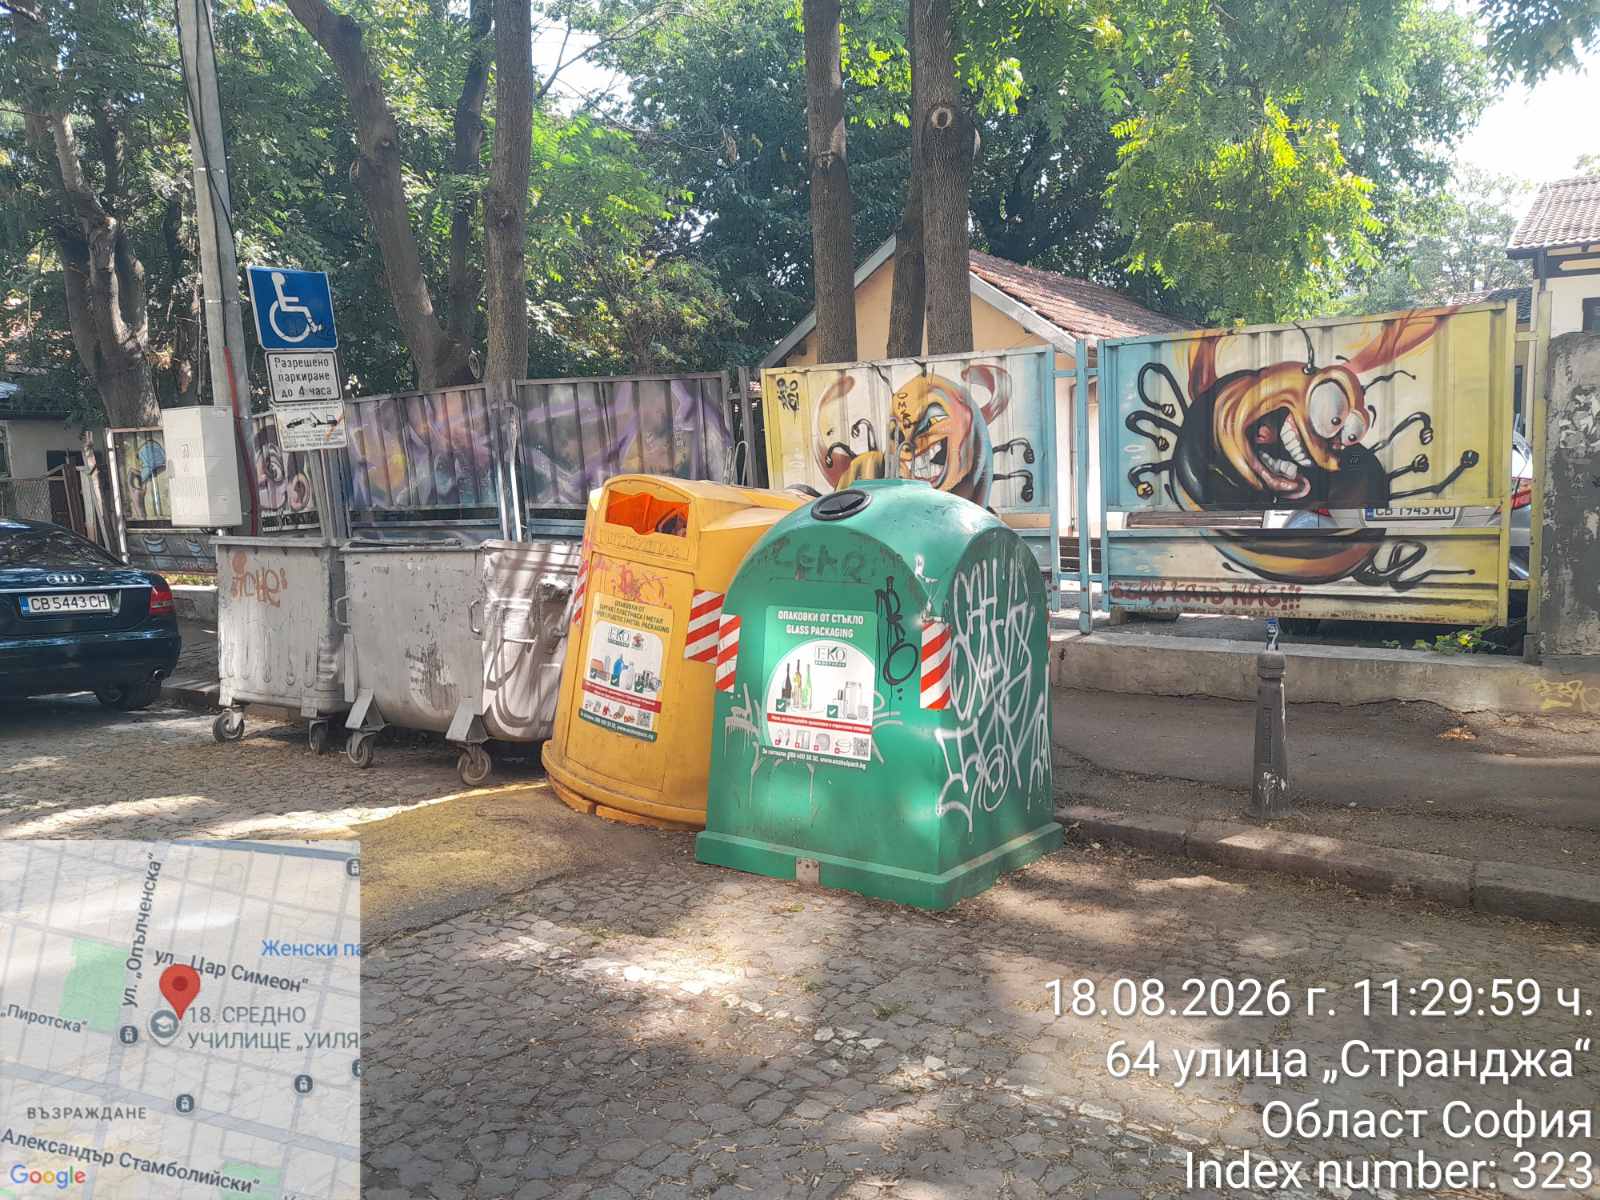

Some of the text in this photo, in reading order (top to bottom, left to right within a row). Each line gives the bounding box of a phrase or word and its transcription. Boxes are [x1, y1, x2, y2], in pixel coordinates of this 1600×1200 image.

[274, 357, 329, 370] Разрешено
[278, 372, 330, 384] паркиране
[281, 385, 332, 398] до 4 часа
[30, 595, 108, 611] CB 5443 CH
[777, 610, 864, 625] ОПАКОВКИ ОТ СТЪКЛО
[786, 624, 854, 639] GLASS PACKAGING
